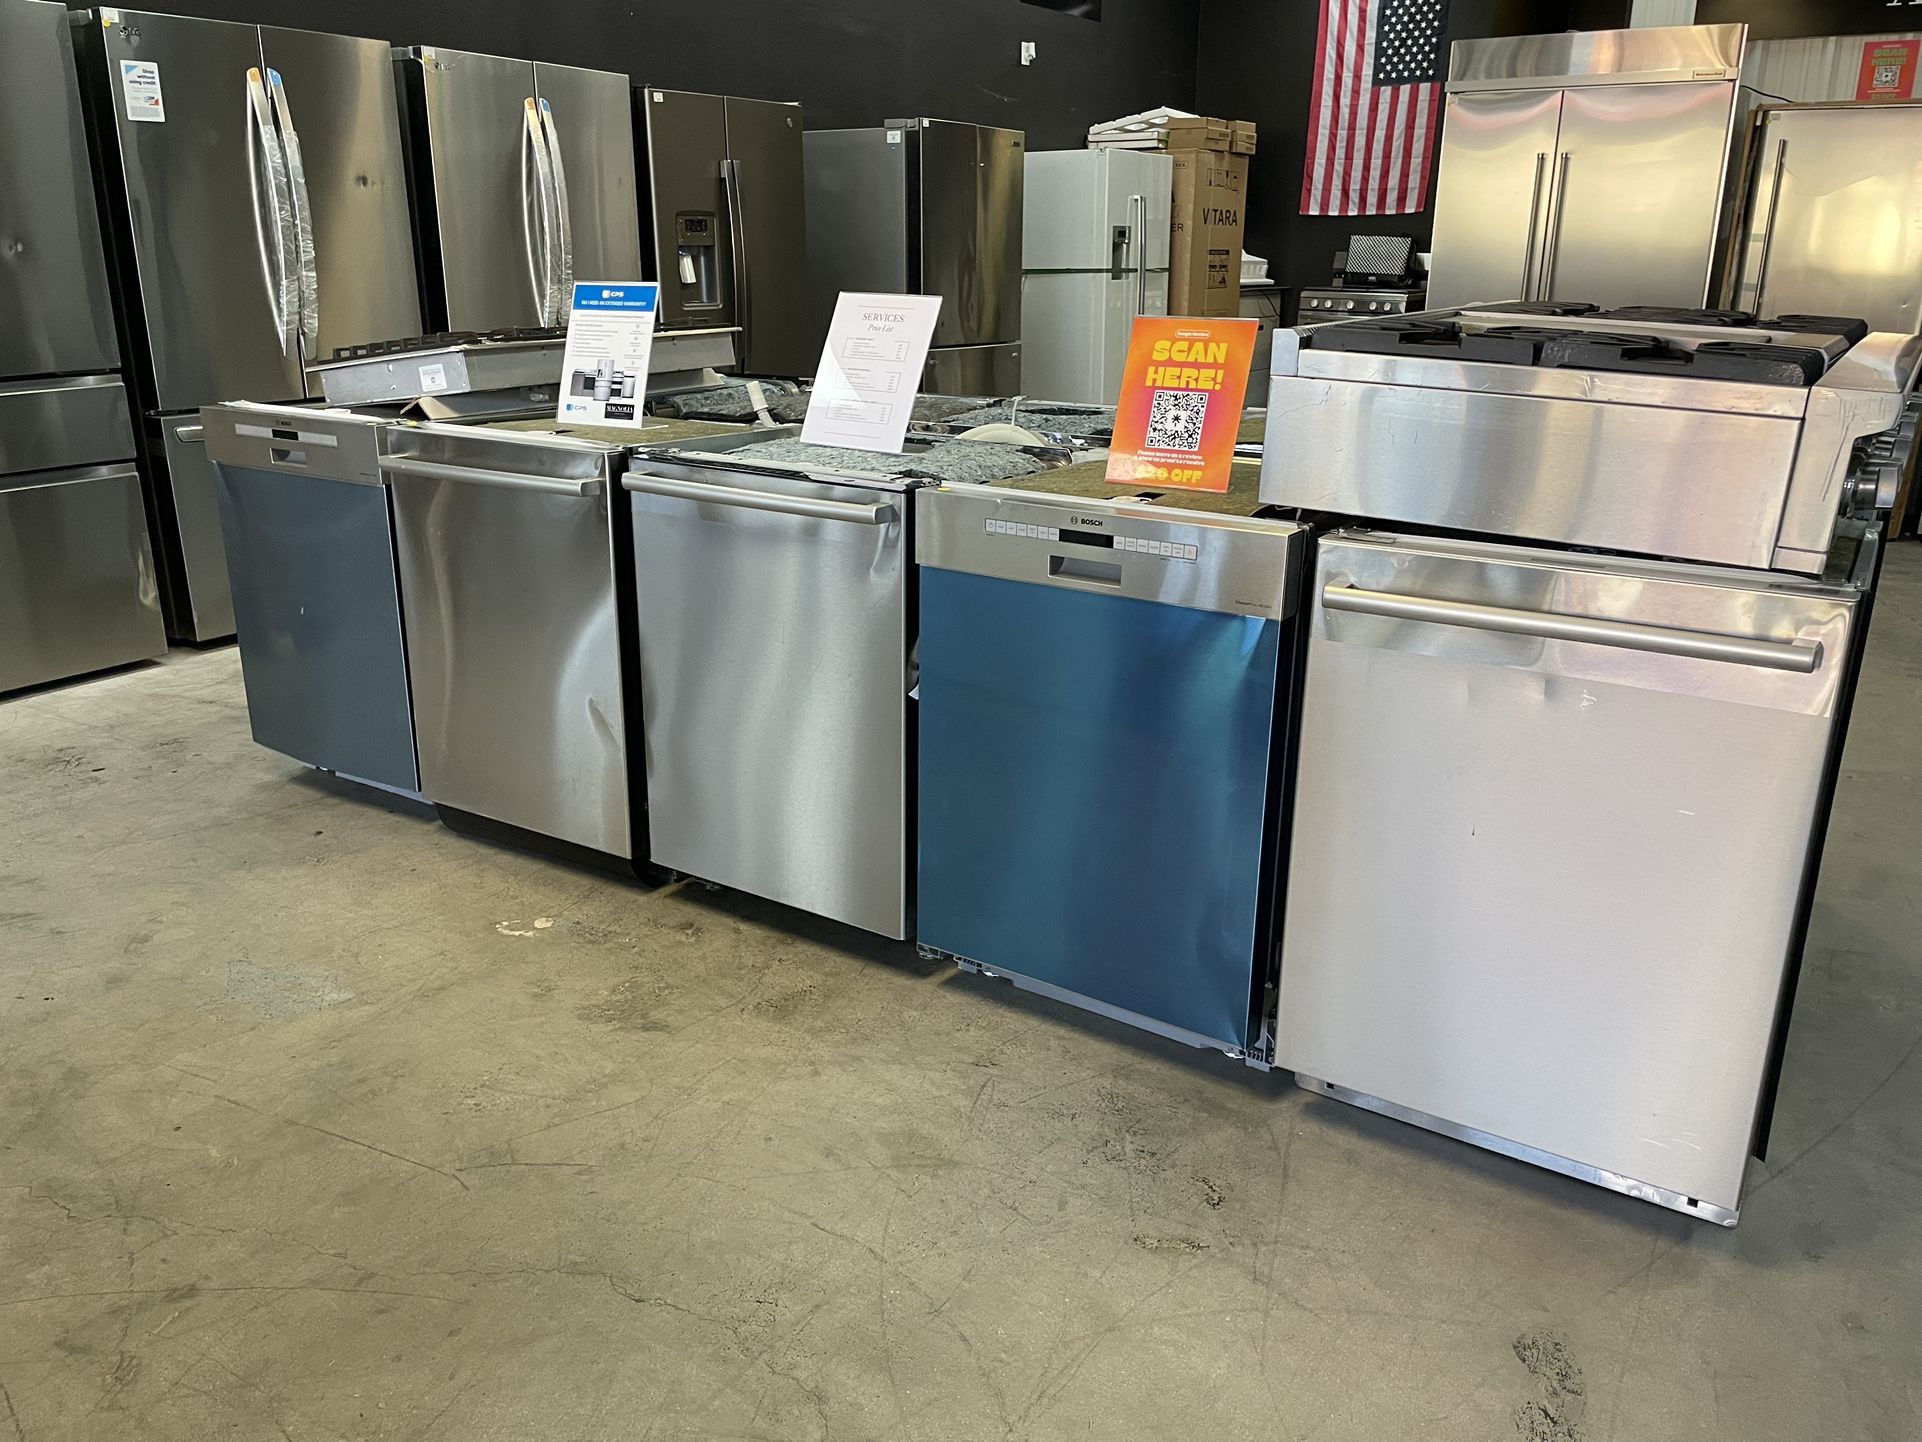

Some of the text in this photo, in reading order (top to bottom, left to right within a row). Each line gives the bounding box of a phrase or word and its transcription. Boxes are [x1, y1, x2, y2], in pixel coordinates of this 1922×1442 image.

[1202, 208, 1238, 226] VTARA
[862, 312, 905, 323] SERVICES
[867, 323, 895, 332] Price List
[1152, 340, 1228, 363] SCAN
[1145, 366, 1225, 391] HERE!
[1170, 468, 1203, 484] OFF
[1081, 518, 1103, 527] BOSCH
